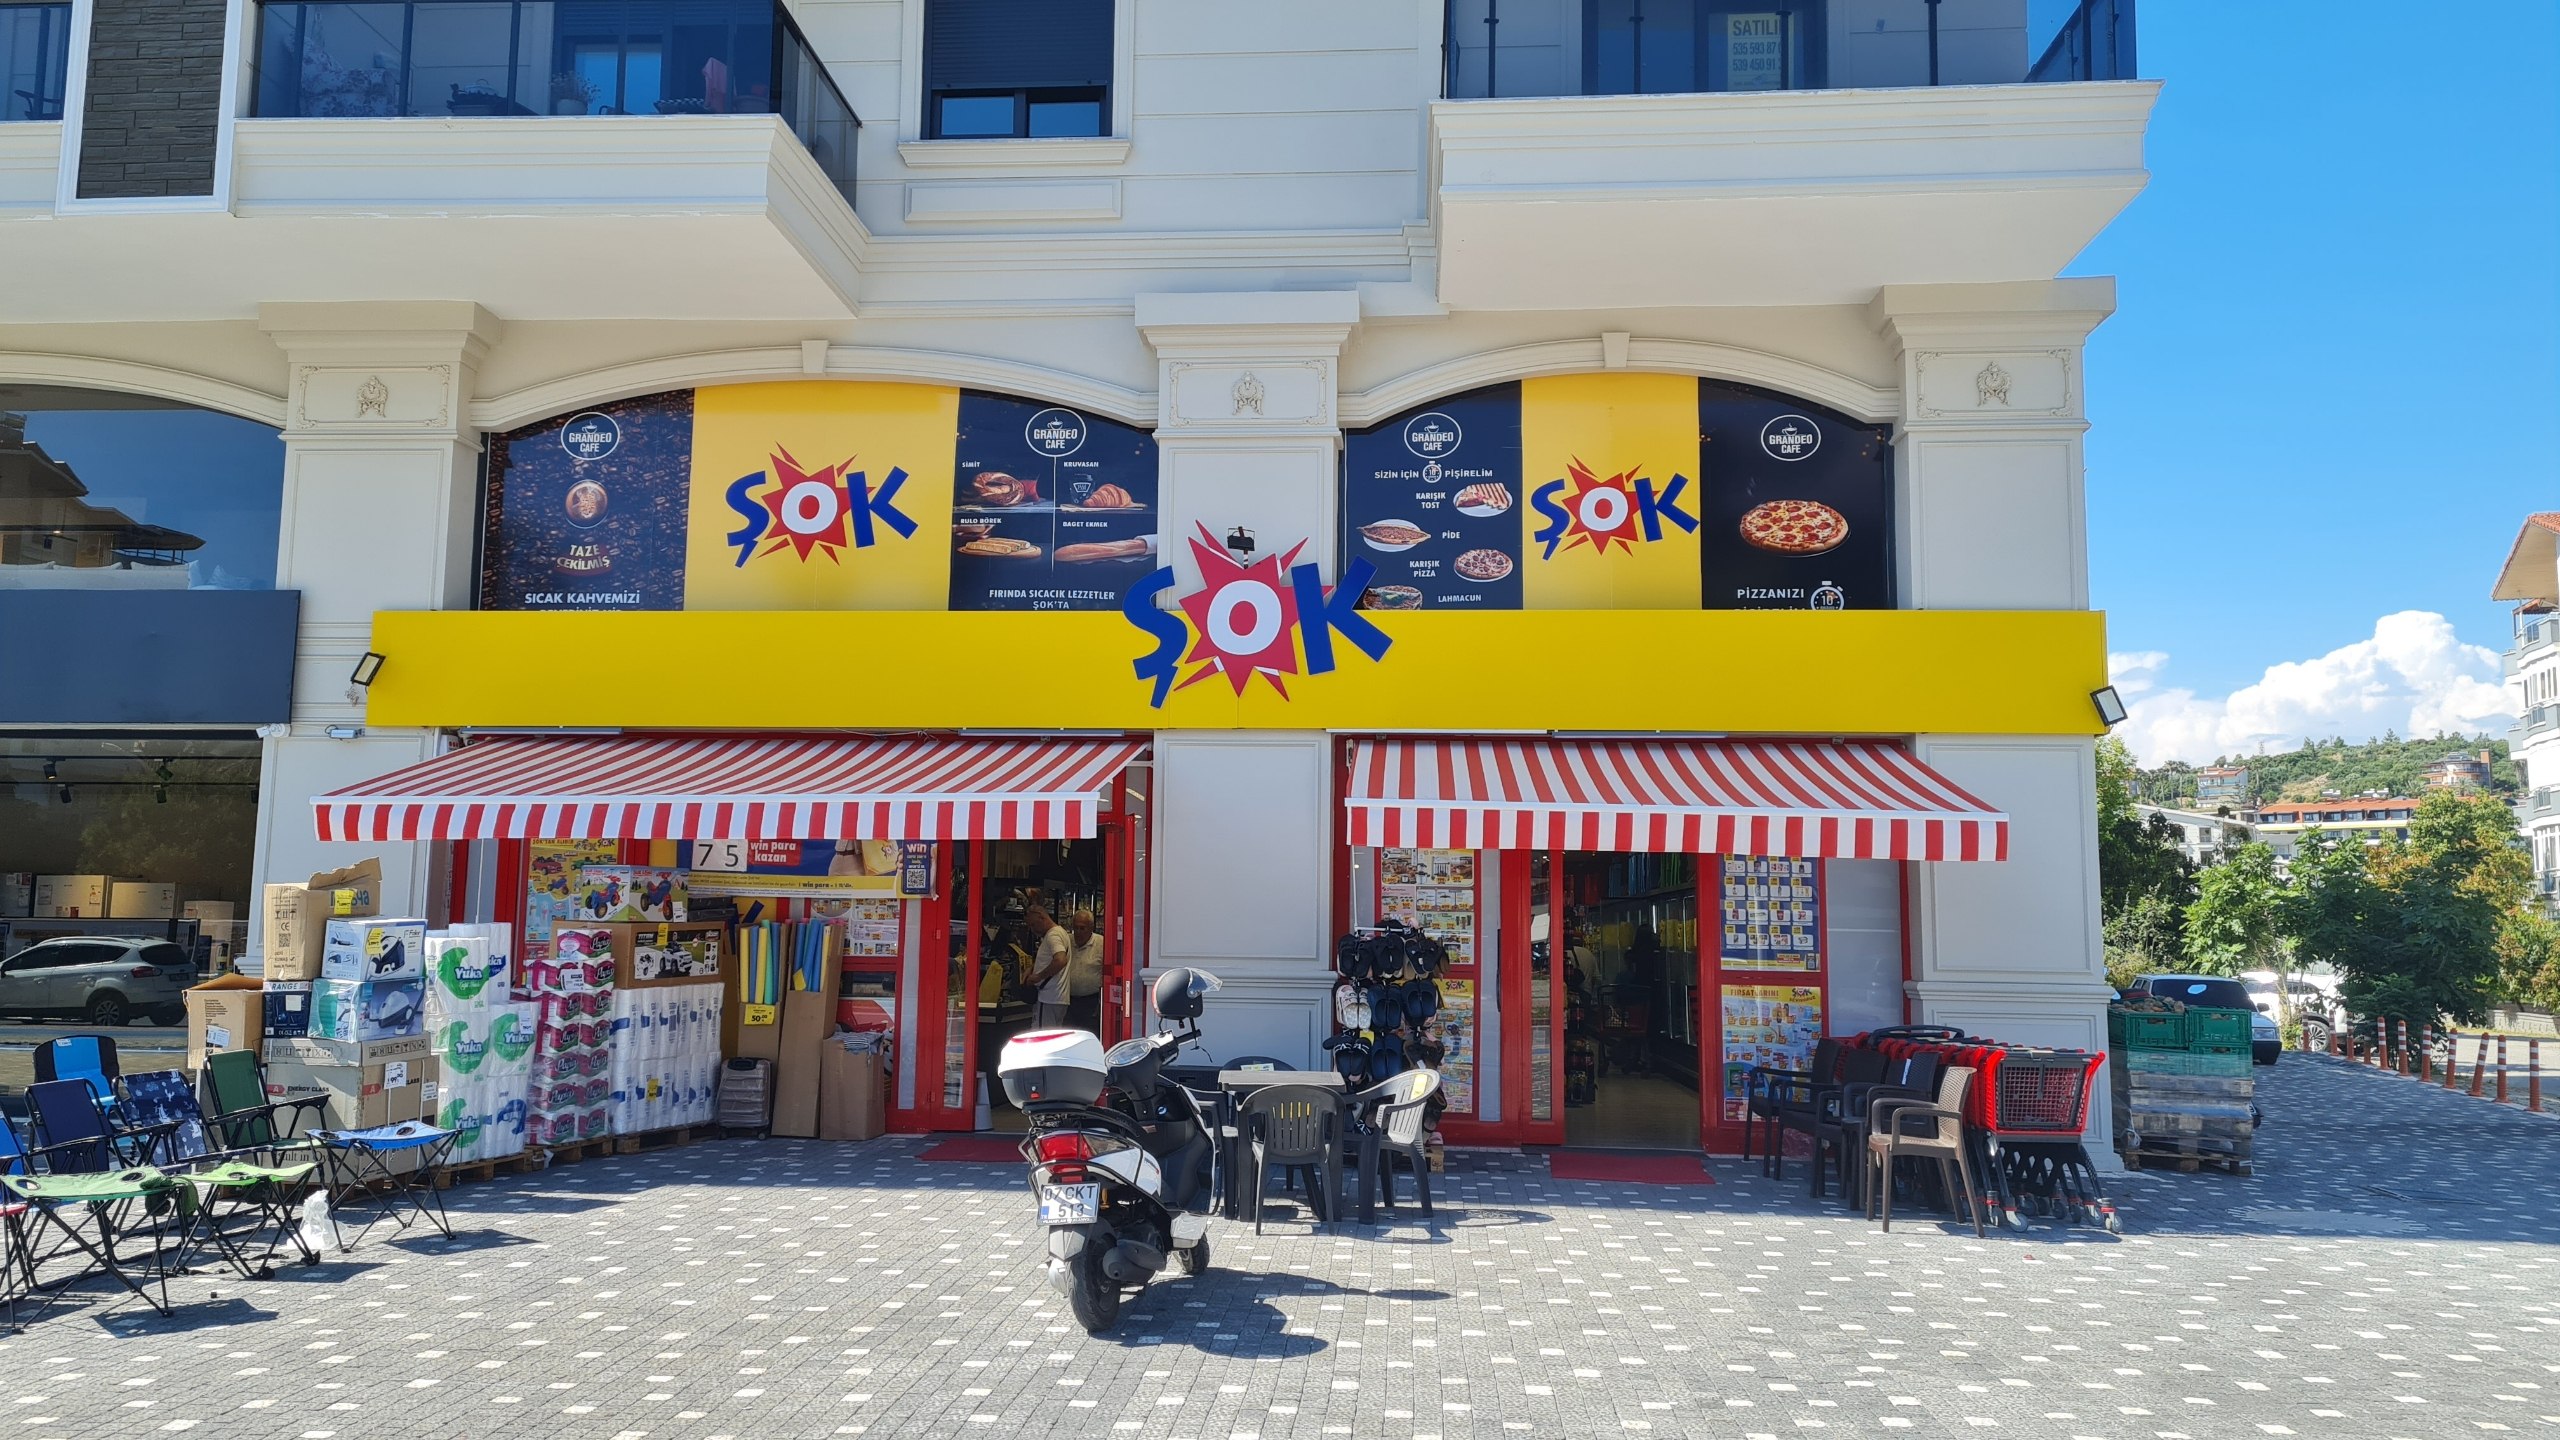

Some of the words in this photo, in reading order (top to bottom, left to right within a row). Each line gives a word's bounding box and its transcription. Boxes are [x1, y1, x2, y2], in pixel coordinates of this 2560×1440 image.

[1733, 19, 1781, 36] SATILI
[568, 432, 612, 443] GRANDEO
[1034, 428, 1078, 440] GRANDEO
[1412, 432, 1454, 442] GRANDEO
[1769, 434, 1813, 444] GRANDEO
[580, 443, 600, 452] CAFE
[1046, 440, 1065, 449] CAFE
[1424, 442, 1442, 451] CAFE
[1782, 444, 1801, 454] CAFE
[1375, 470, 1398, 479] SİZİN
[1401, 469, 1419, 480] İÇİN
[1445, 469, 1493, 480] PİŞİRELİM
[1416, 492, 1446, 500] KARIŞIK
[726, 465, 918, 568] ŞOK
[1531, 472, 1700, 561] ŞOK
[1442, 530, 1460, 539] PİDE
[570, 544, 600, 557] TAZE
[557, 556, 610, 570] ÇEKİLMİŞ
[1410, 560, 1440, 569] KARIŞIK
[1414, 569, 1436, 578] PİZZA
[525, 592, 562, 604] SICAK
[567, 590, 640, 604] KAHVEMİZİ
[989, 589, 1026, 598] FIRINDA
[1029, 590, 1065, 598] SICACIK
[1068, 590, 1115, 600] LEZZETLER
[1438, 594, 1482, 603] LAHMACUN
[1033, 601, 1070, 610] ŞOK'TA
[1122, 554, 1394, 709] ŞOK
[750, 841, 769, 851] win
[771, 841, 796, 852] para
[907, 844, 927, 853] win
[698, 844, 714, 866] 7
[724, 845, 738, 866] 5
[755, 852, 786, 863] kazan
[454, 966, 482, 980] Yuka
[504, 1032, 529, 1044] Yuka
[456, 1040, 482, 1054] Yuka
[455, 1116, 480, 1129] Yuka
[1045, 1186, 1062, 1200] 07
[1066, 1185, 1096, 1200] CKT
[1059, 1204, 1084, 1217] 513
